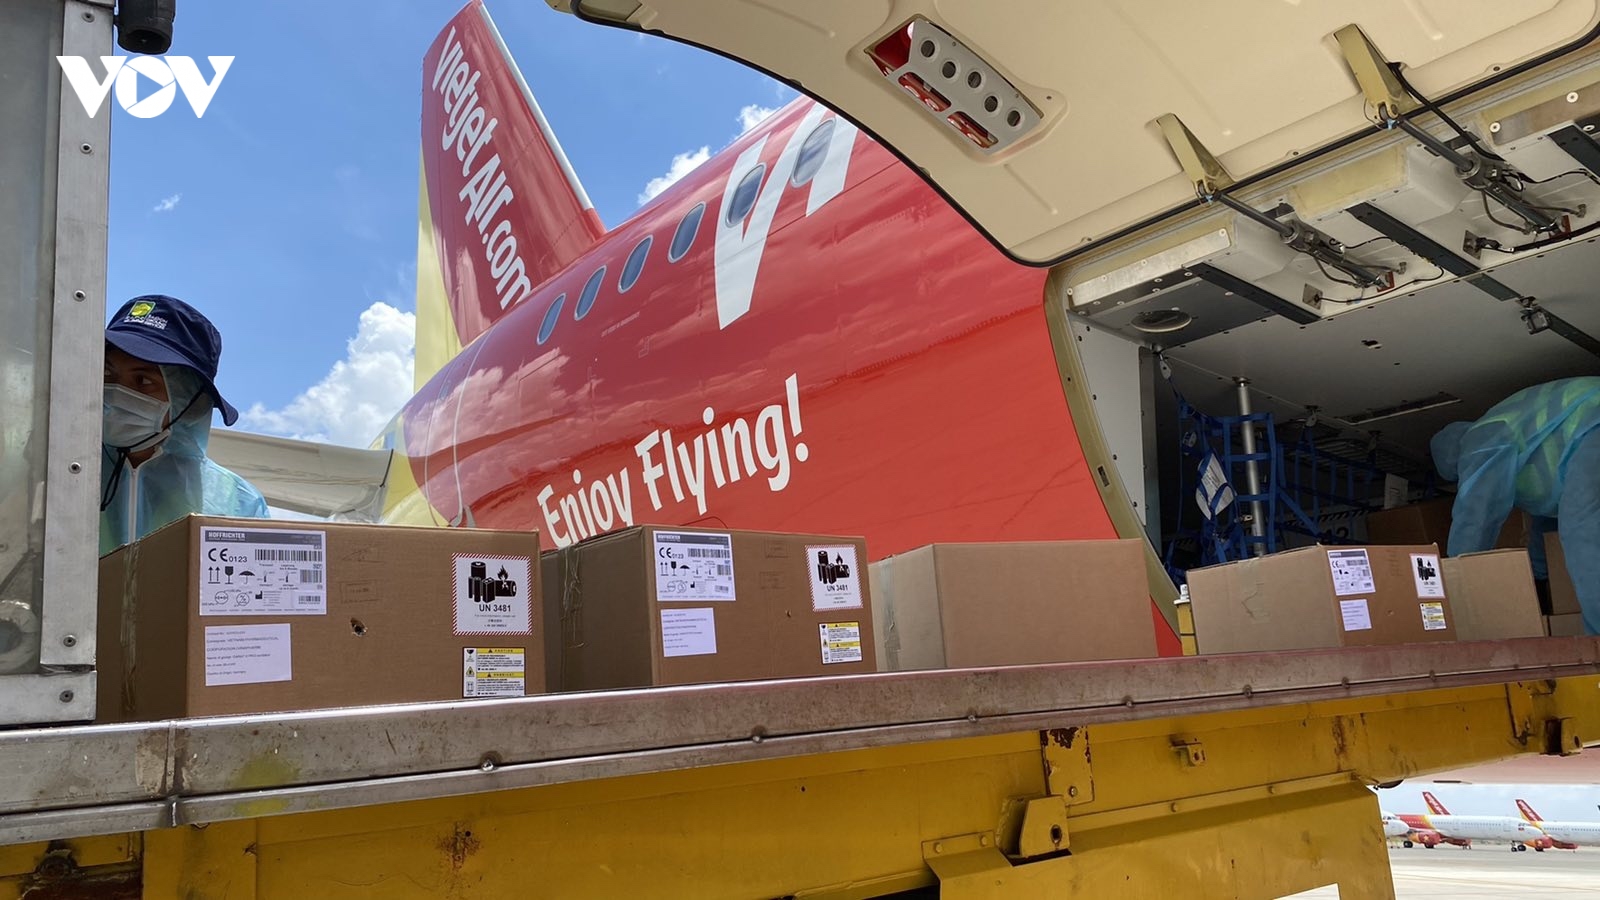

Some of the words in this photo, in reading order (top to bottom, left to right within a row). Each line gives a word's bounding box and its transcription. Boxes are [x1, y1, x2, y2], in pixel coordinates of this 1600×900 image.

[536, 467, 635, 550] Enjoy
[634, 372, 809, 517] Flying!
[228, 555, 248, 563] 0123
[826, 584, 836, 592] UN
[479, 604, 492, 612] UN
[493, 604, 511, 612] 3481
